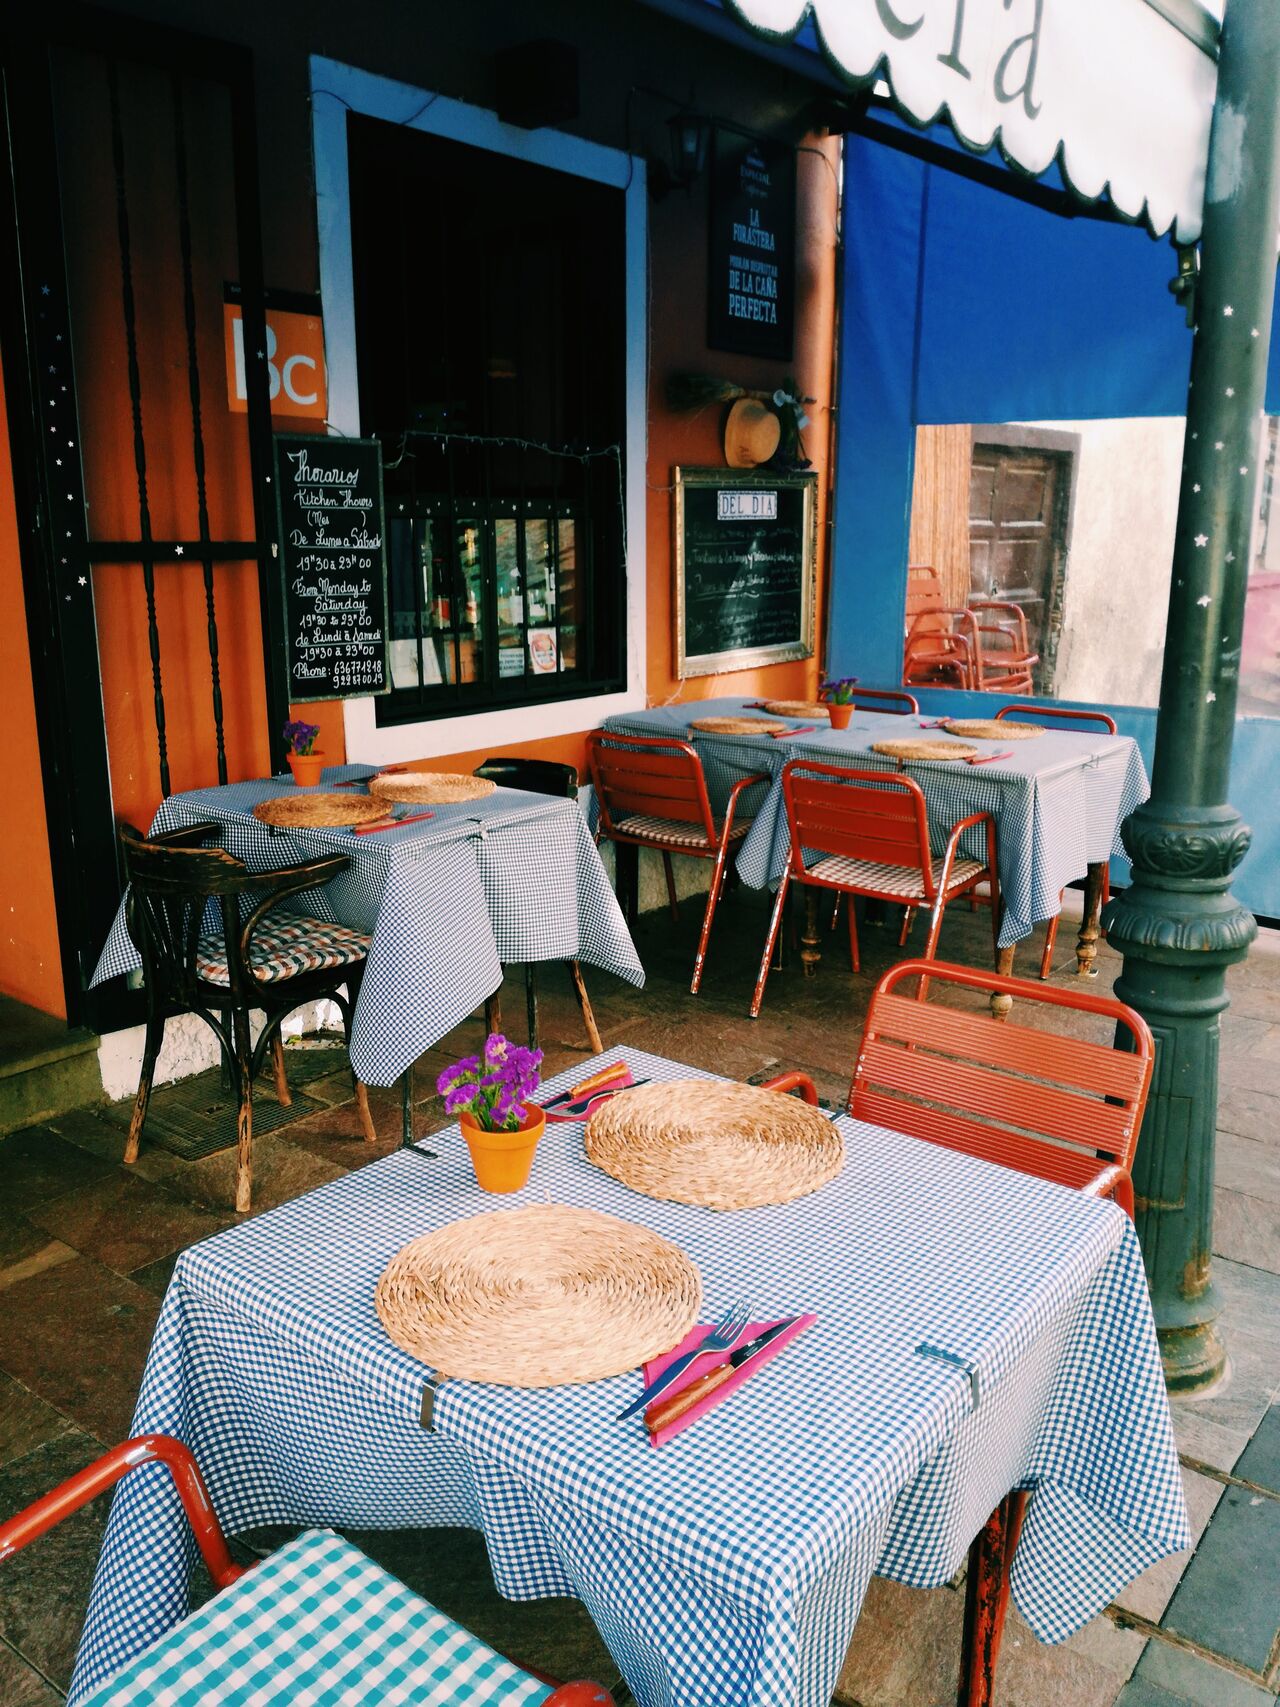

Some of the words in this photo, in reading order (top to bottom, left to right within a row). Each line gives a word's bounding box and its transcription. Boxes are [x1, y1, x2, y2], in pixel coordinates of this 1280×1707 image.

[750, 208, 760, 227] LA
[733, 223, 775, 251] FORASTERA
[729, 270, 740, 290] DE
[742, 272, 753, 293] LA
[755, 275, 778, 299] CAÑA
[728, 293, 777, 324] PERFECTA
[293, 488, 339, 507] Kitchen
[722, 495, 744, 515] DEL
[289, 528, 309, 546] De
[291, 576, 319, 595] From
[318, 577, 359, 600] Monday
[360, 578, 372, 592] to
[314, 597, 369, 616] Saturday
[295, 631, 310, 648] de
[312, 627, 342, 644] Lundi
